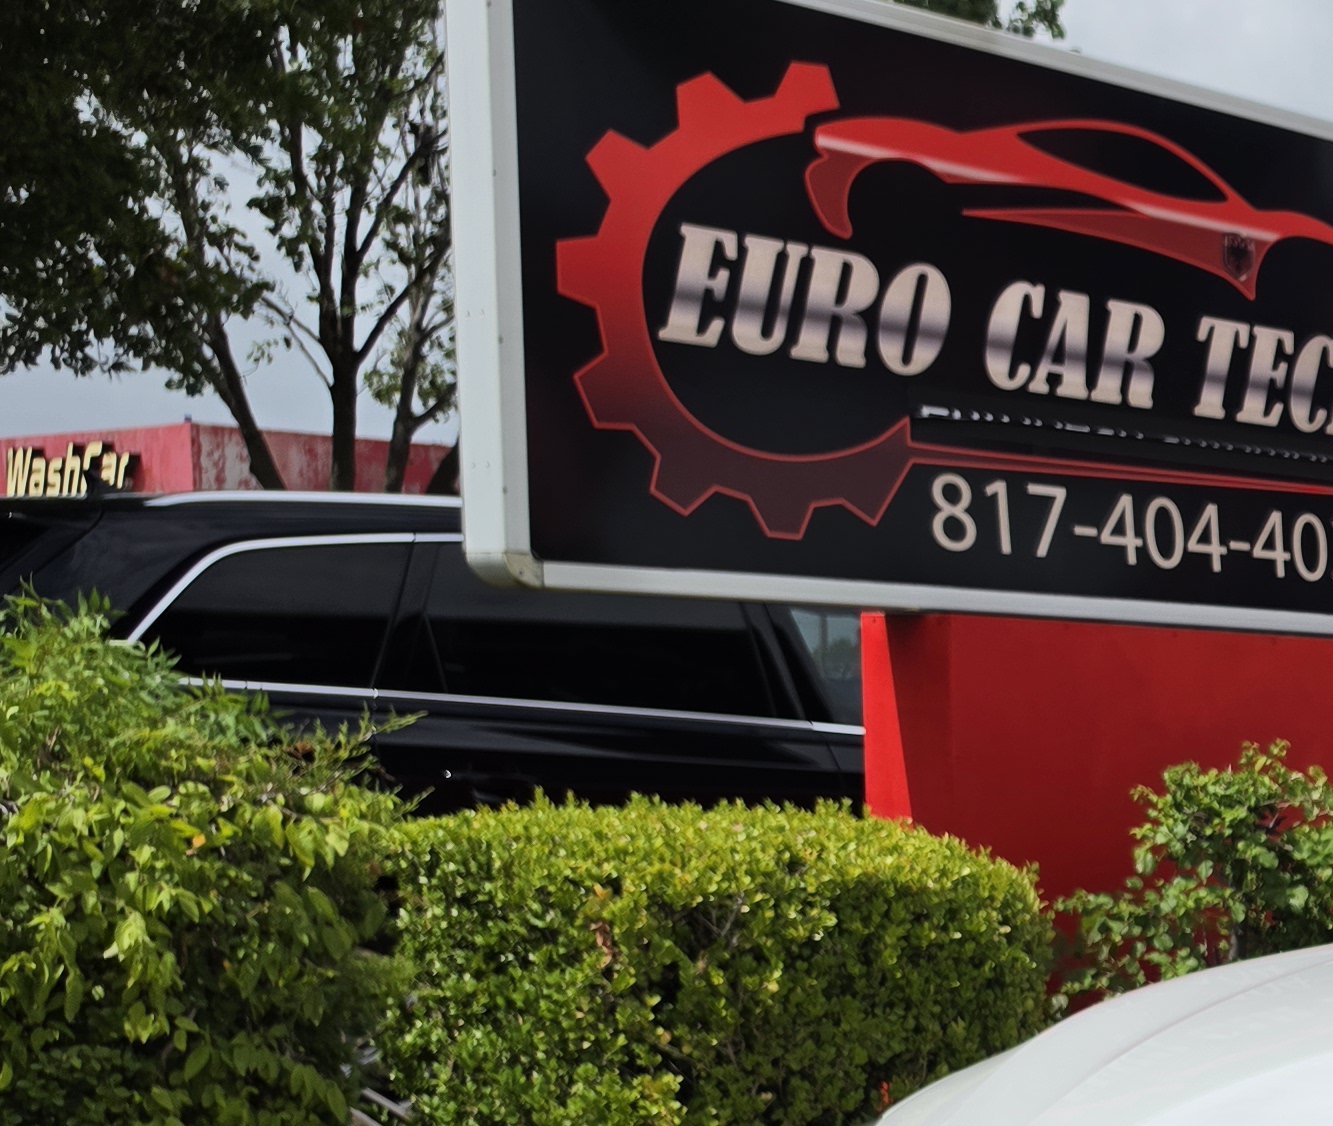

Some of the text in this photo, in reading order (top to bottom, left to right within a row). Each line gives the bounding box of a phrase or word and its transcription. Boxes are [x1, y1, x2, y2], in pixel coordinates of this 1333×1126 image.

[657, 222, 952, 377] EURO
[985, 277, 1166, 411] CAR
[7, 442, 81, 498] Wash
